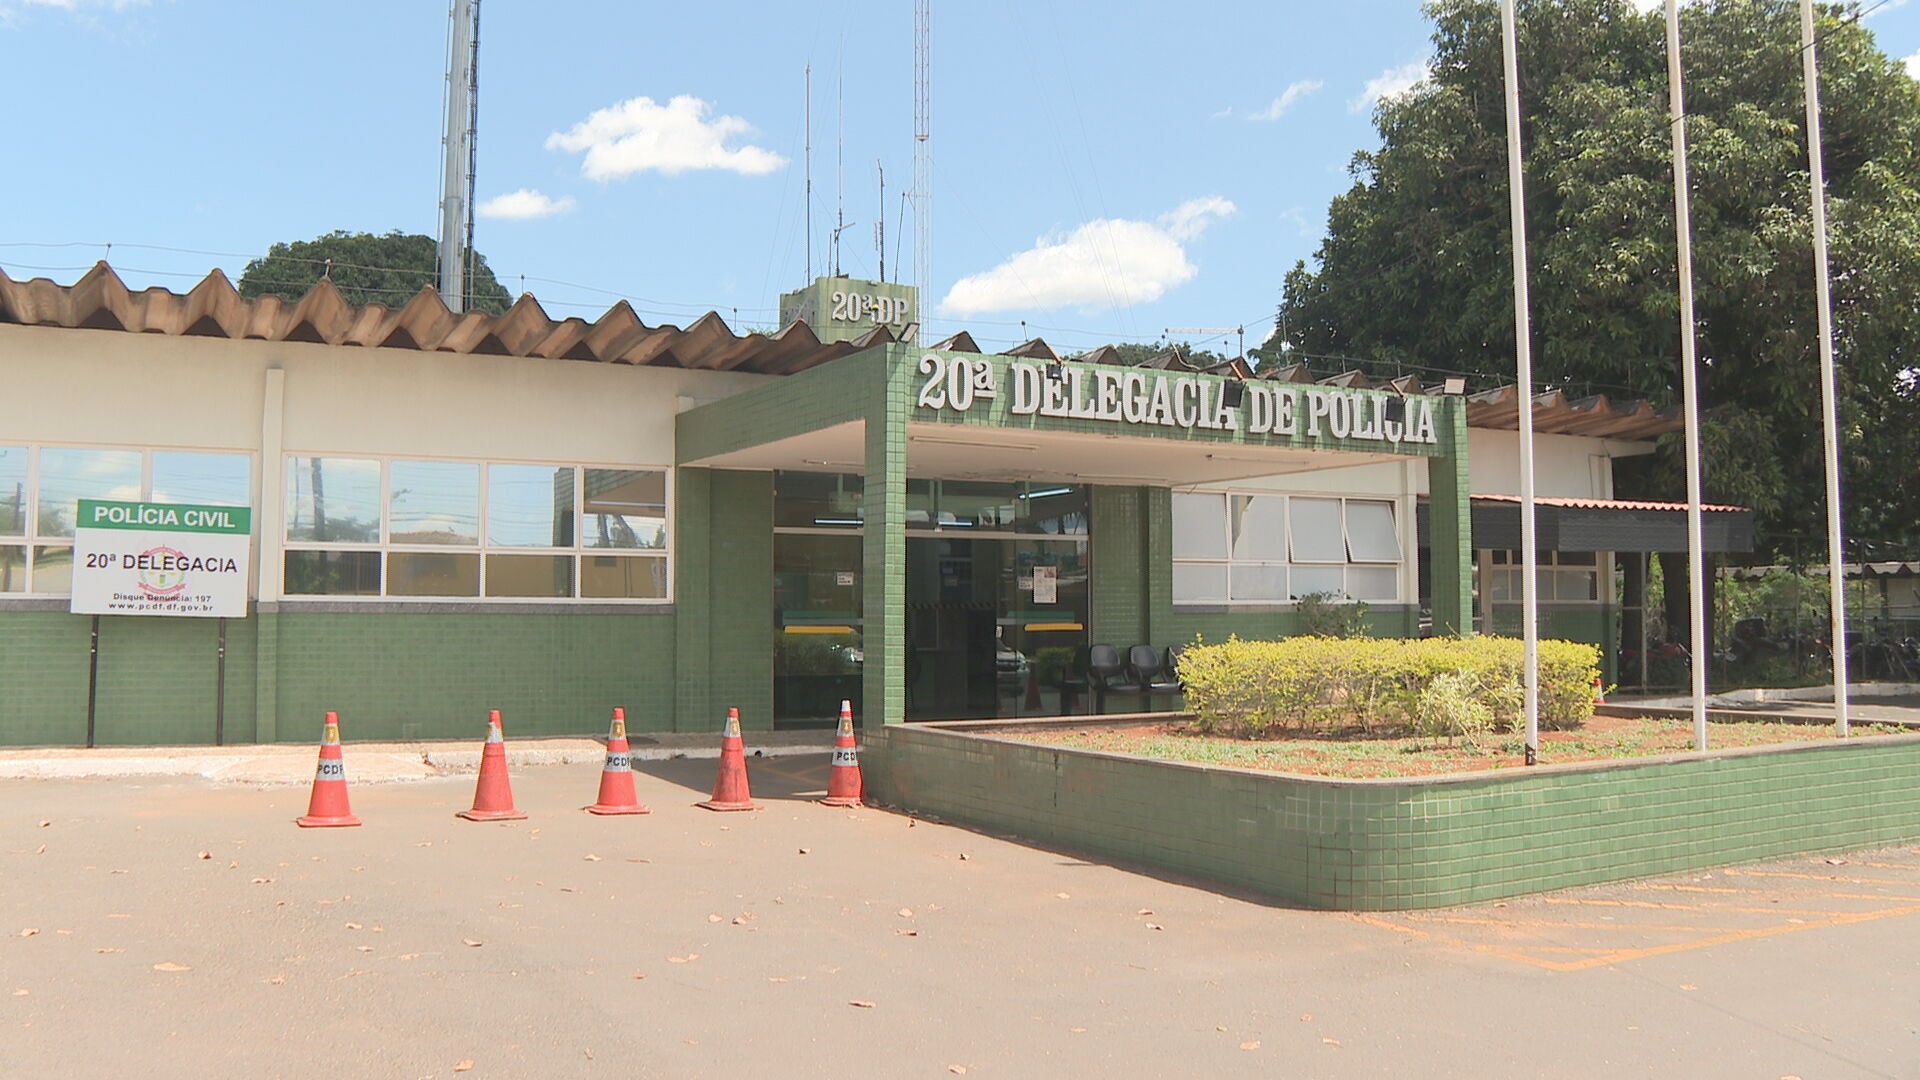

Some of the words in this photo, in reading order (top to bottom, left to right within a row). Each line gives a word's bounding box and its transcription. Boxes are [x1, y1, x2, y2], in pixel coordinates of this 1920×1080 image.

[876, 295, 909, 326] DP
[918, 353, 998, 412] 20ª
[1011, 362, 1237, 430] DELEGACIA
[1249, 386, 1297, 435] DE
[94, 504, 179, 526] POLÍCIA
[184, 511, 236, 528] CIVIL
[86, 553, 117, 569] 20ª
[123, 554, 238, 573] DELEGACIA
[108, 602, 213, 612] www.pcdf.df.gov.br
[113, 592, 144, 602] Disque
